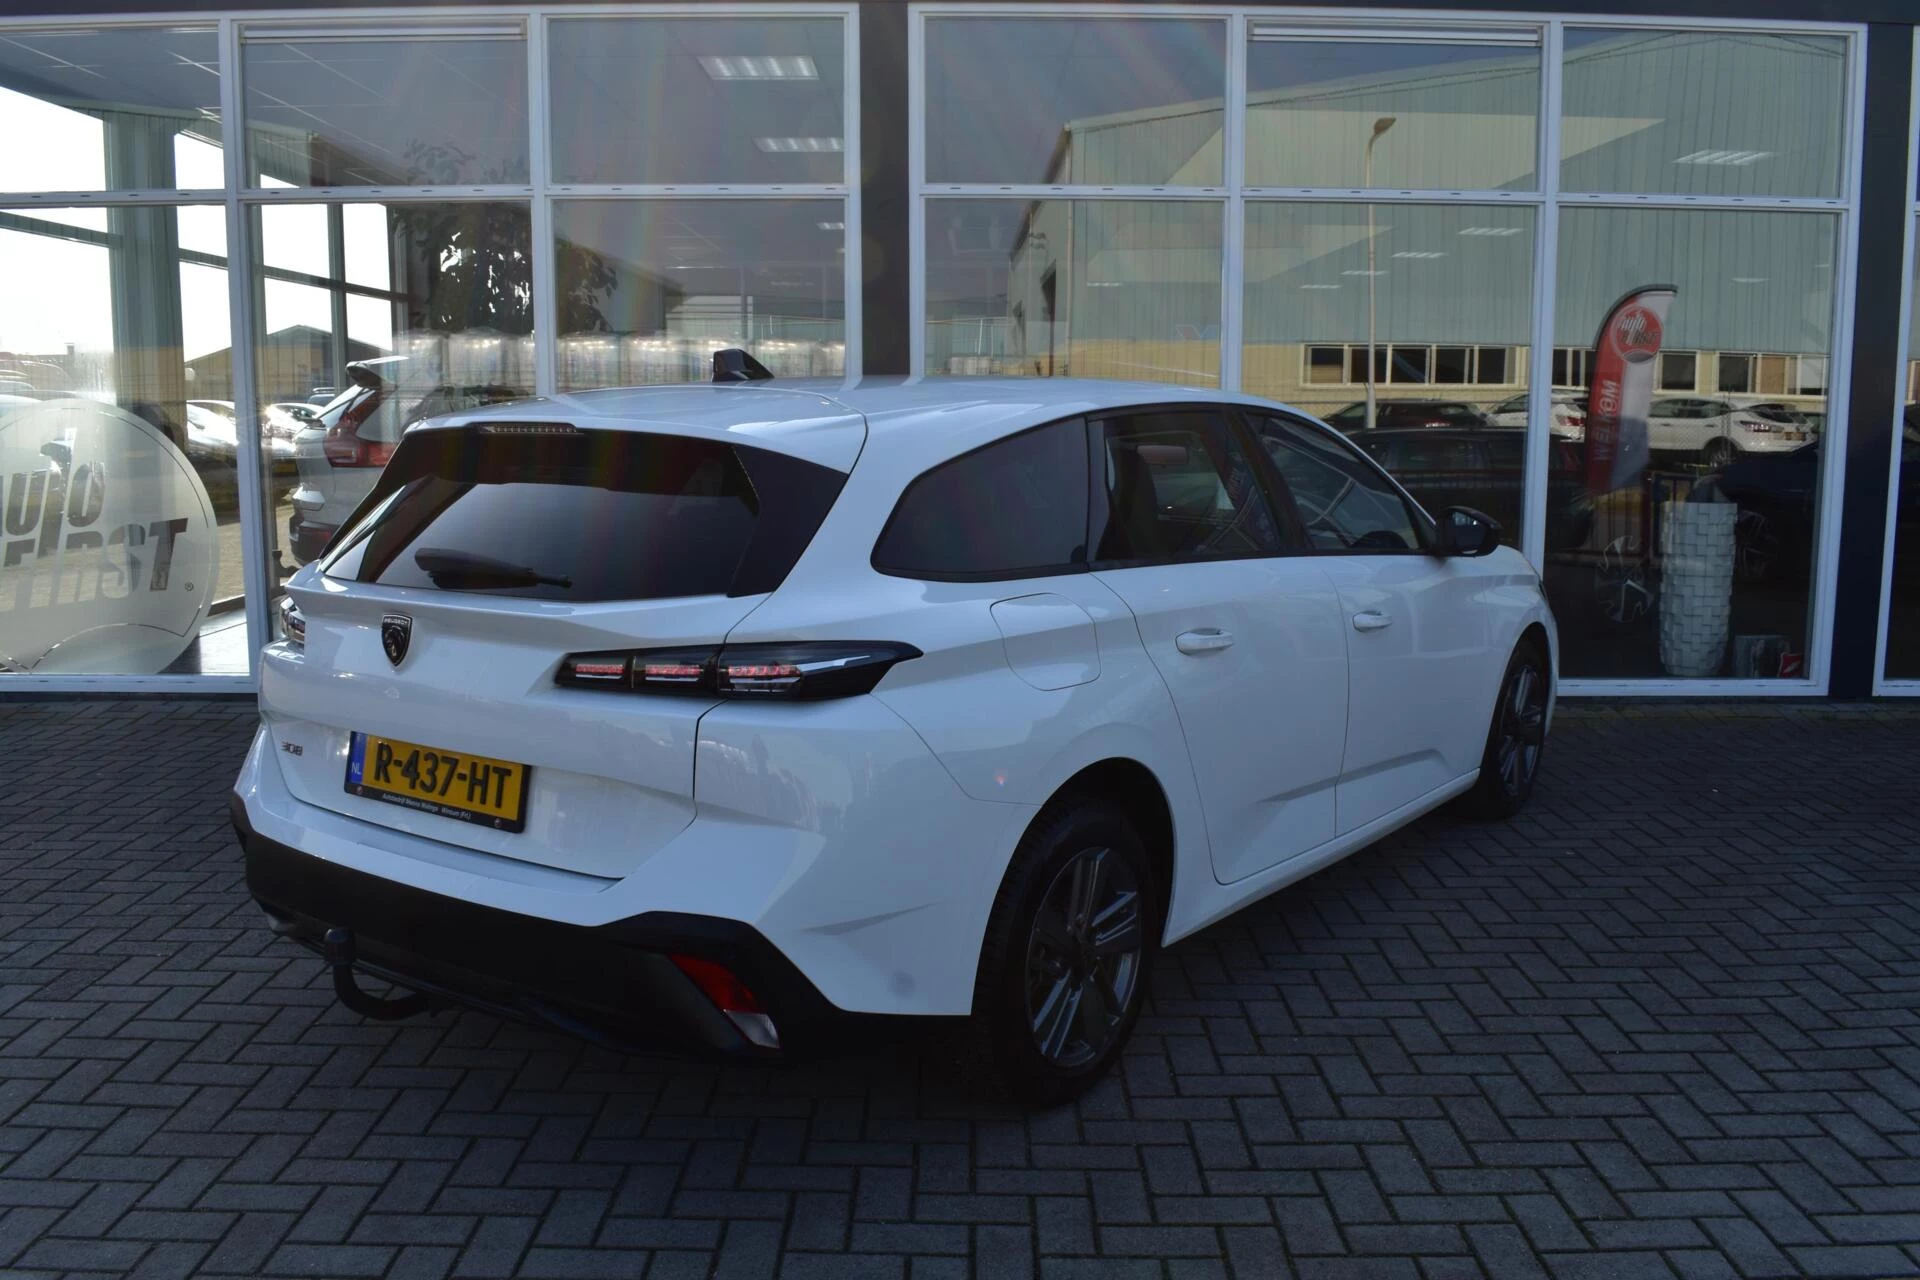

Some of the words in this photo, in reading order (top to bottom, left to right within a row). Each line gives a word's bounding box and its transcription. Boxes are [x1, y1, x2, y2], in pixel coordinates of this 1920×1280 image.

[1593, 379, 1618, 461] WELKOM
[0, 428, 105, 538] UTO
[281, 740, 303, 756] 308
[352, 763, 361, 775] NL
[374, 742, 512, 808] R-437-HT
